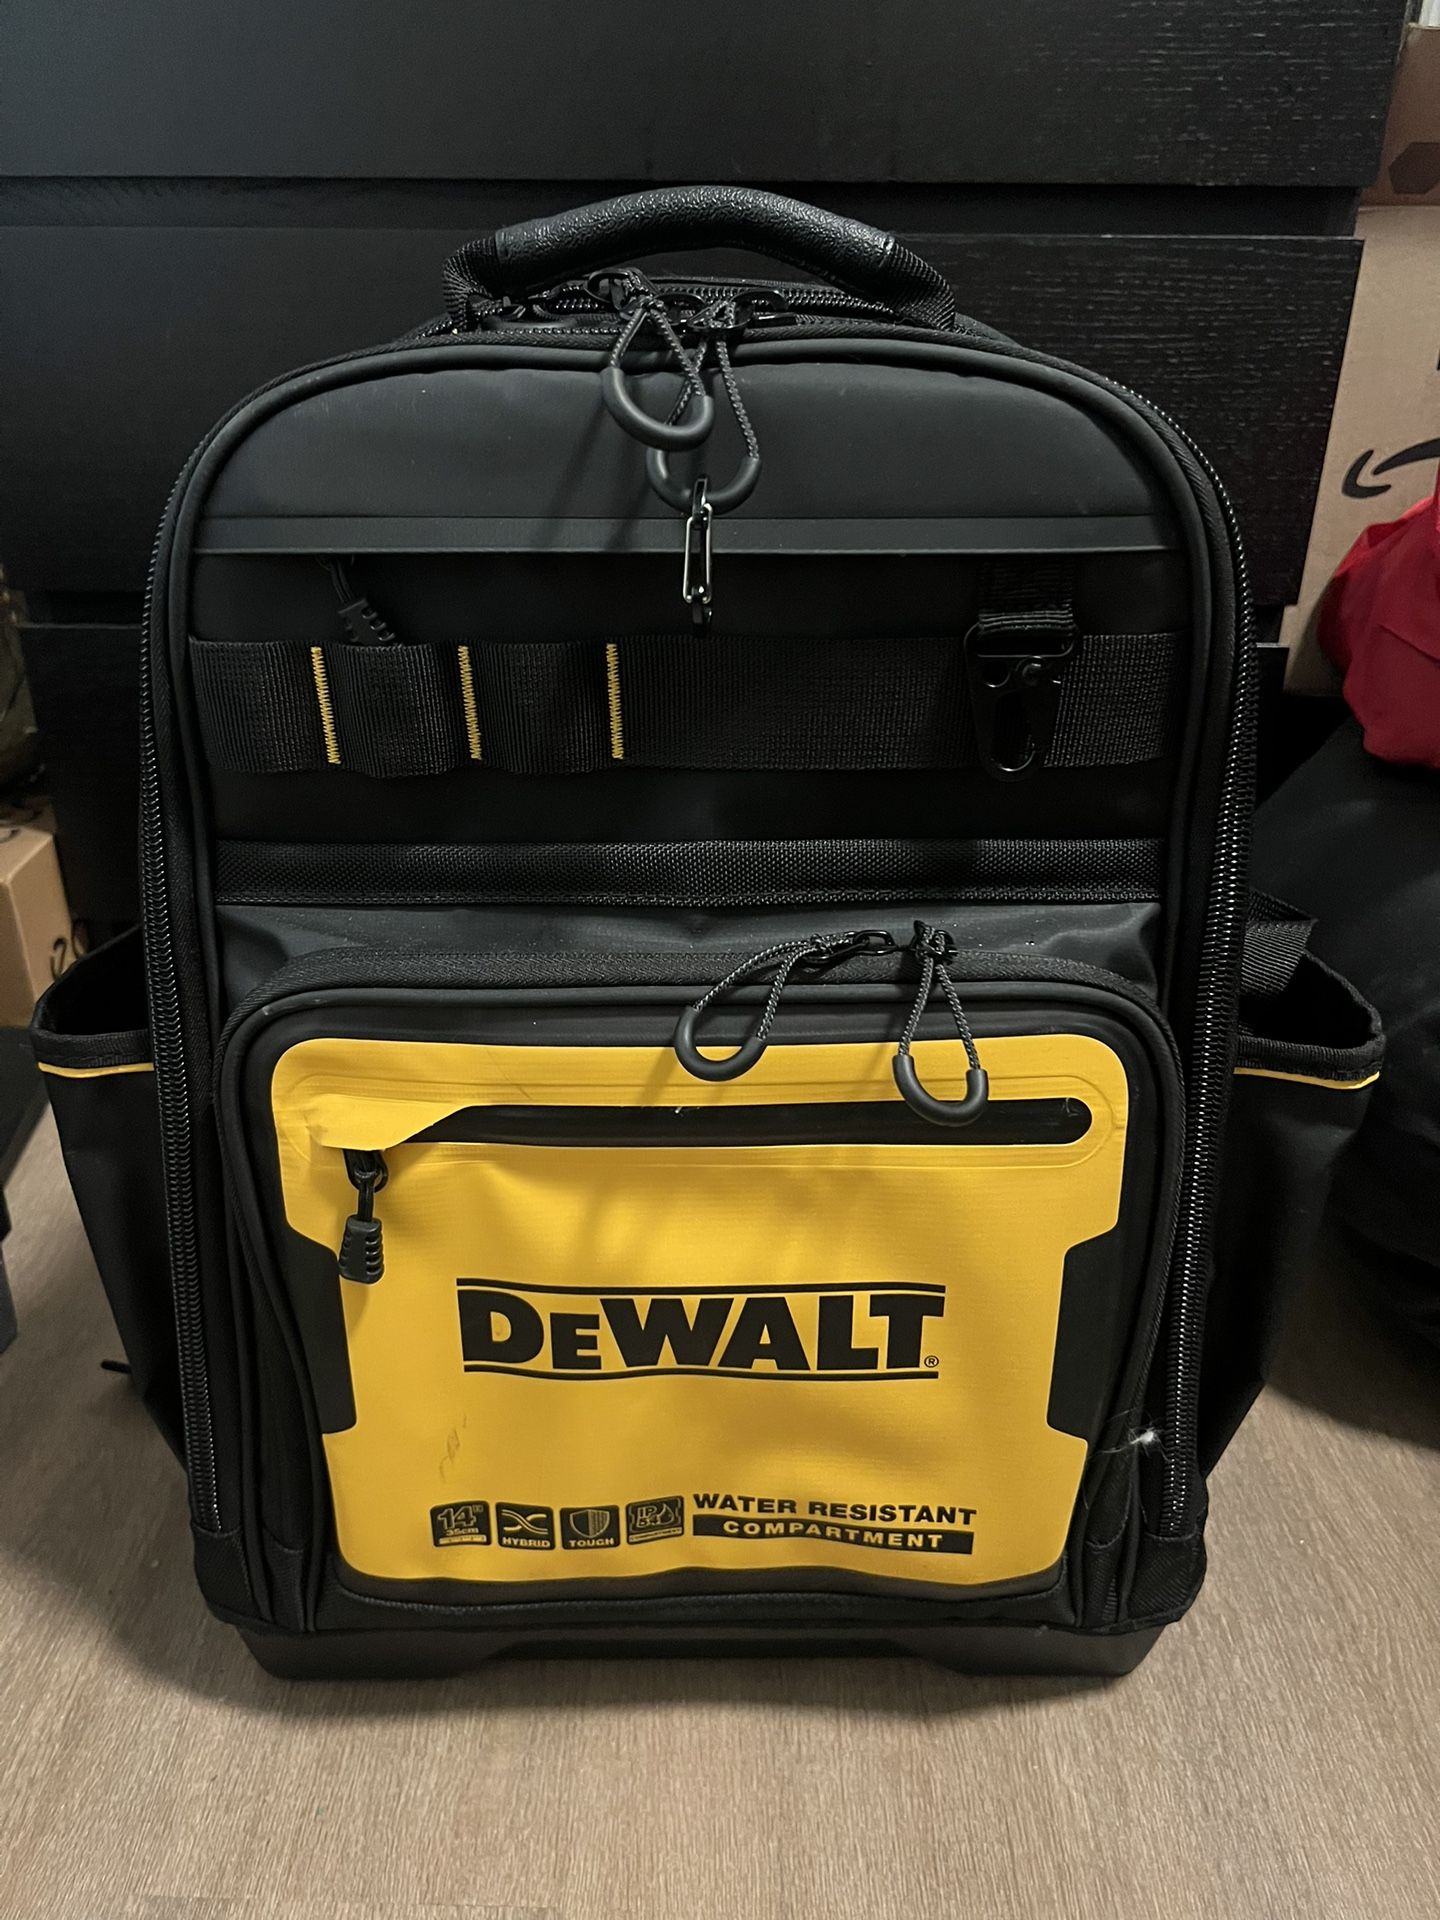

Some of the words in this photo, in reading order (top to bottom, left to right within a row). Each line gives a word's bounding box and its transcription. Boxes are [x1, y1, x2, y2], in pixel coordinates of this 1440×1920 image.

[457, 1288, 946, 1370] DEWALT
[693, 1493, 798, 1514] WATER
[808, 1501, 977, 1525] RESISTANT
[502, 1536, 551, 1548] HYBRID
[568, 1537, 615, 1548] TOUGH
[723, 1520, 943, 1548] COMPARTMENT
